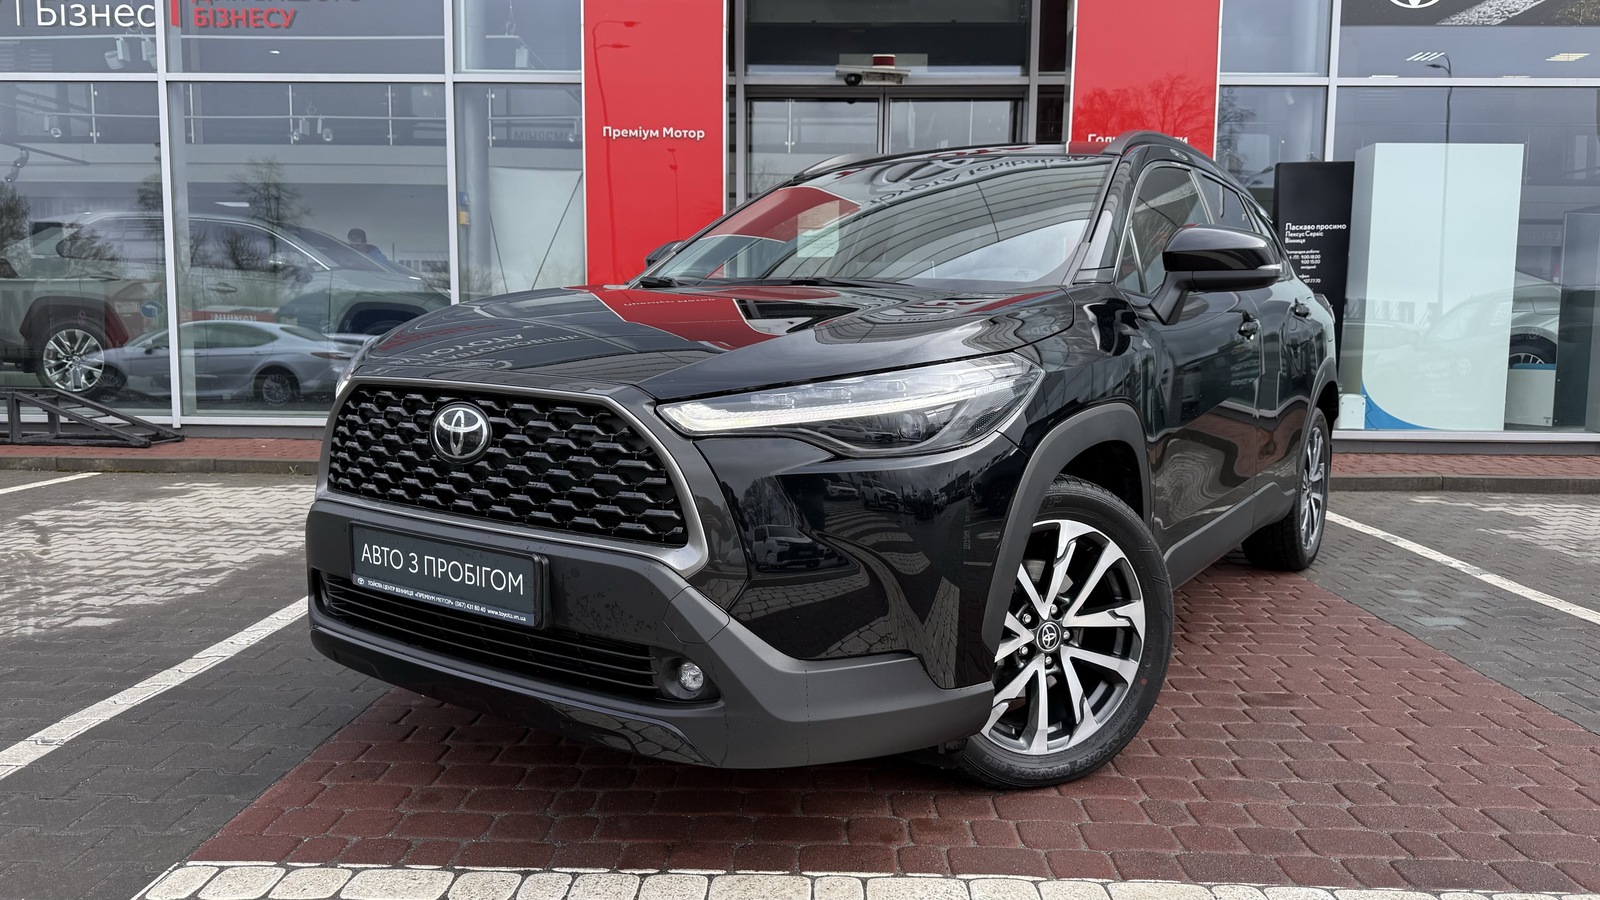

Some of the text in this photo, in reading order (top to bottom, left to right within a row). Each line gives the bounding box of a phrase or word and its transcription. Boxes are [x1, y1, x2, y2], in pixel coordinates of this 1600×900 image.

[193, 8, 296, 28] БІЗНЕСУ
[603, 126, 705, 141] Преміум Мотор
[1285, 223, 1315, 231] Ласкаво
[361, 543, 523, 596] АВТО З ПРОБІГОМ
